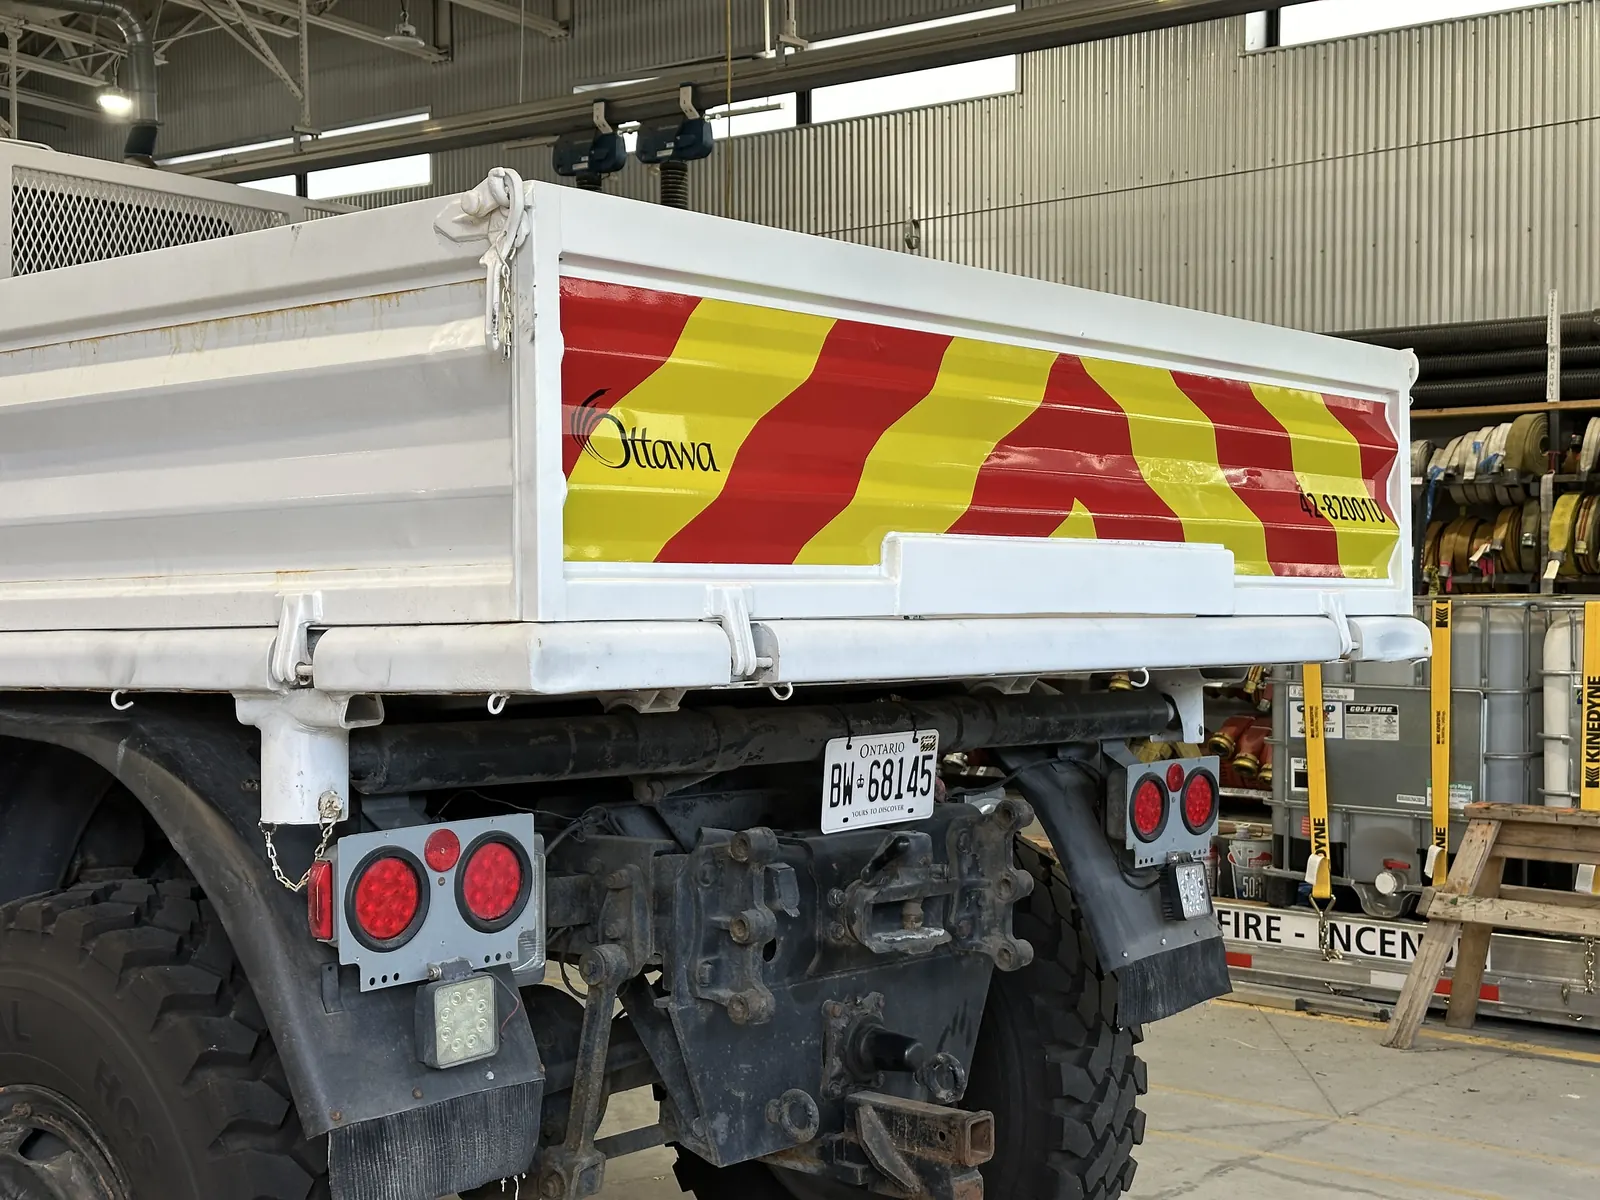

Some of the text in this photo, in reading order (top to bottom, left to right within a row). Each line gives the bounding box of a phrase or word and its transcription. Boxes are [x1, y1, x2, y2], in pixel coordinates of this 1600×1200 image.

[570, 388, 720, 472] Ottawa
[1585, 676, 1600, 763] KINEDYNE
[859, 741, 905, 759] ONTARIO
[829, 754, 934, 808] BW 68145
[851, 804, 904, 818] YOURS TO DISCOVER
[1313, 818, 1327, 857] DYNE
[1217, 909, 1282, 944] FIRE
